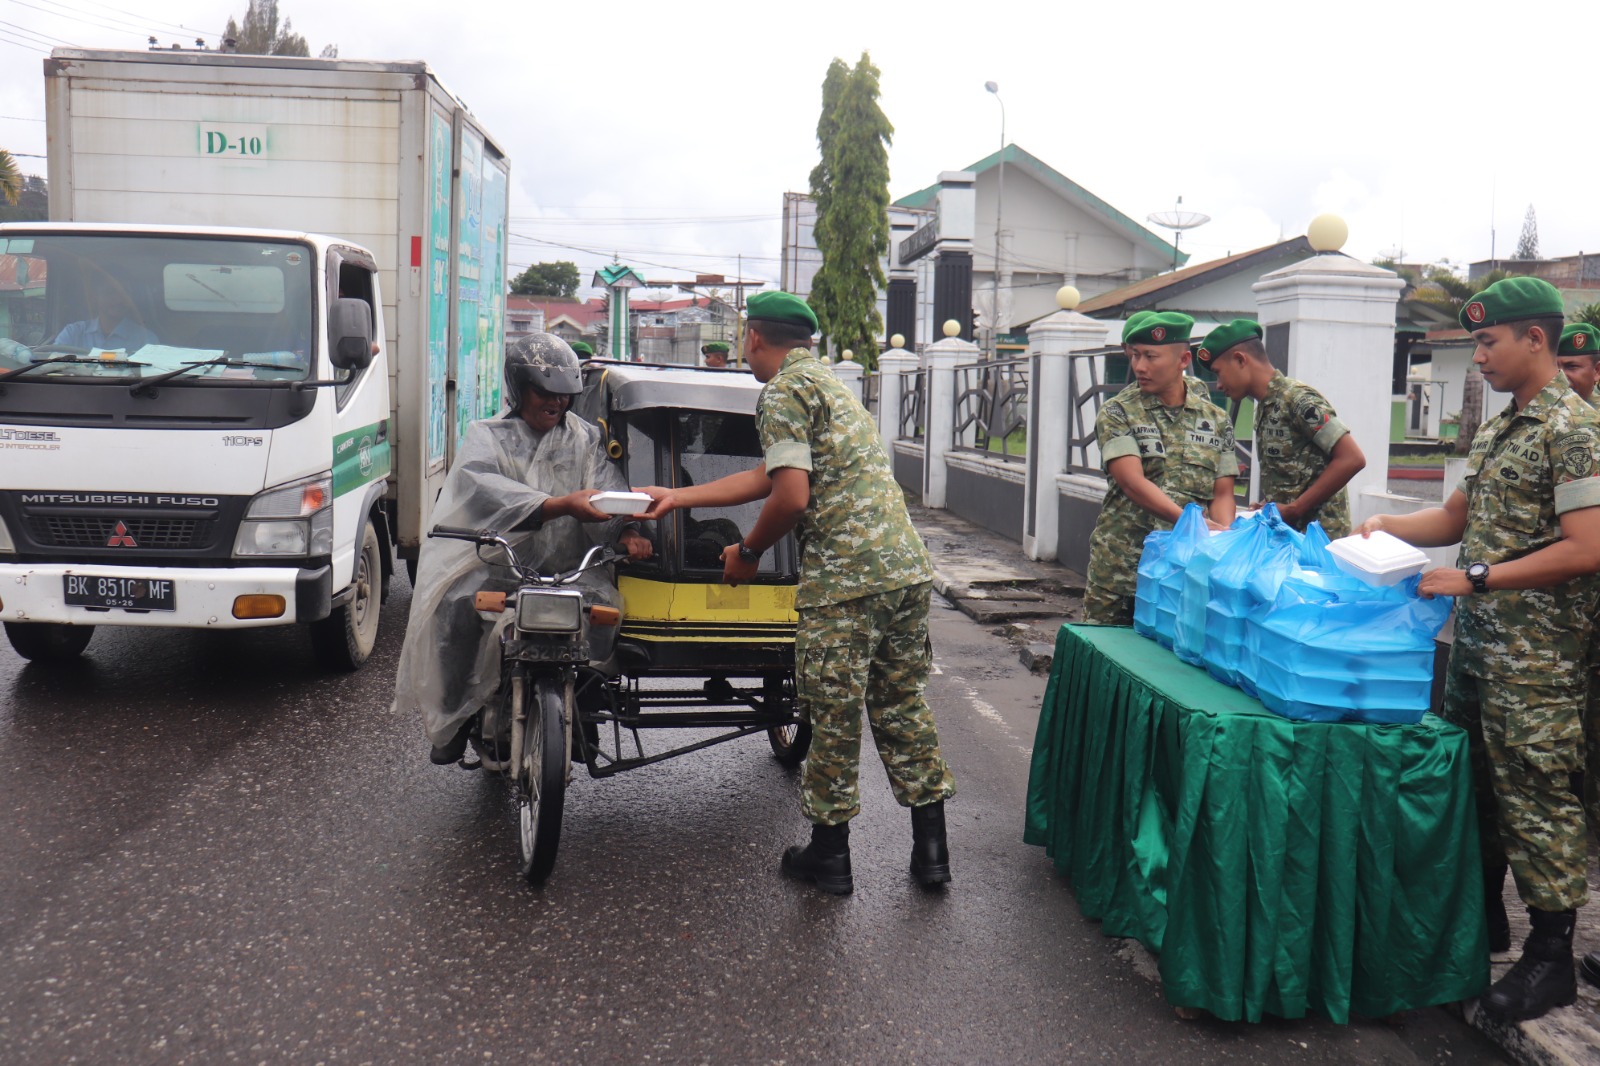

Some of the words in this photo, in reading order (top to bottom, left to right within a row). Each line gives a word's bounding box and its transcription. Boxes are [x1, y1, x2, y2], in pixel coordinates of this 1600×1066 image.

[206, 131, 262, 155] D-10
[222, 436, 263, 446] 110PS
[1190, 434, 1205, 443] TNI
[1208, 437, 1220, 446] AD
[5, 443, 61, 451] INTERCOOLER
[1506, 442, 1520, 454] TNI
[1520, 448, 1540, 462] AD
[22, 495, 148, 504] MITSUBISHI
[157, 496, 219, 506] FUSO
[68, 576, 88, 595] BK
[149, 581, 170, 599] MF
